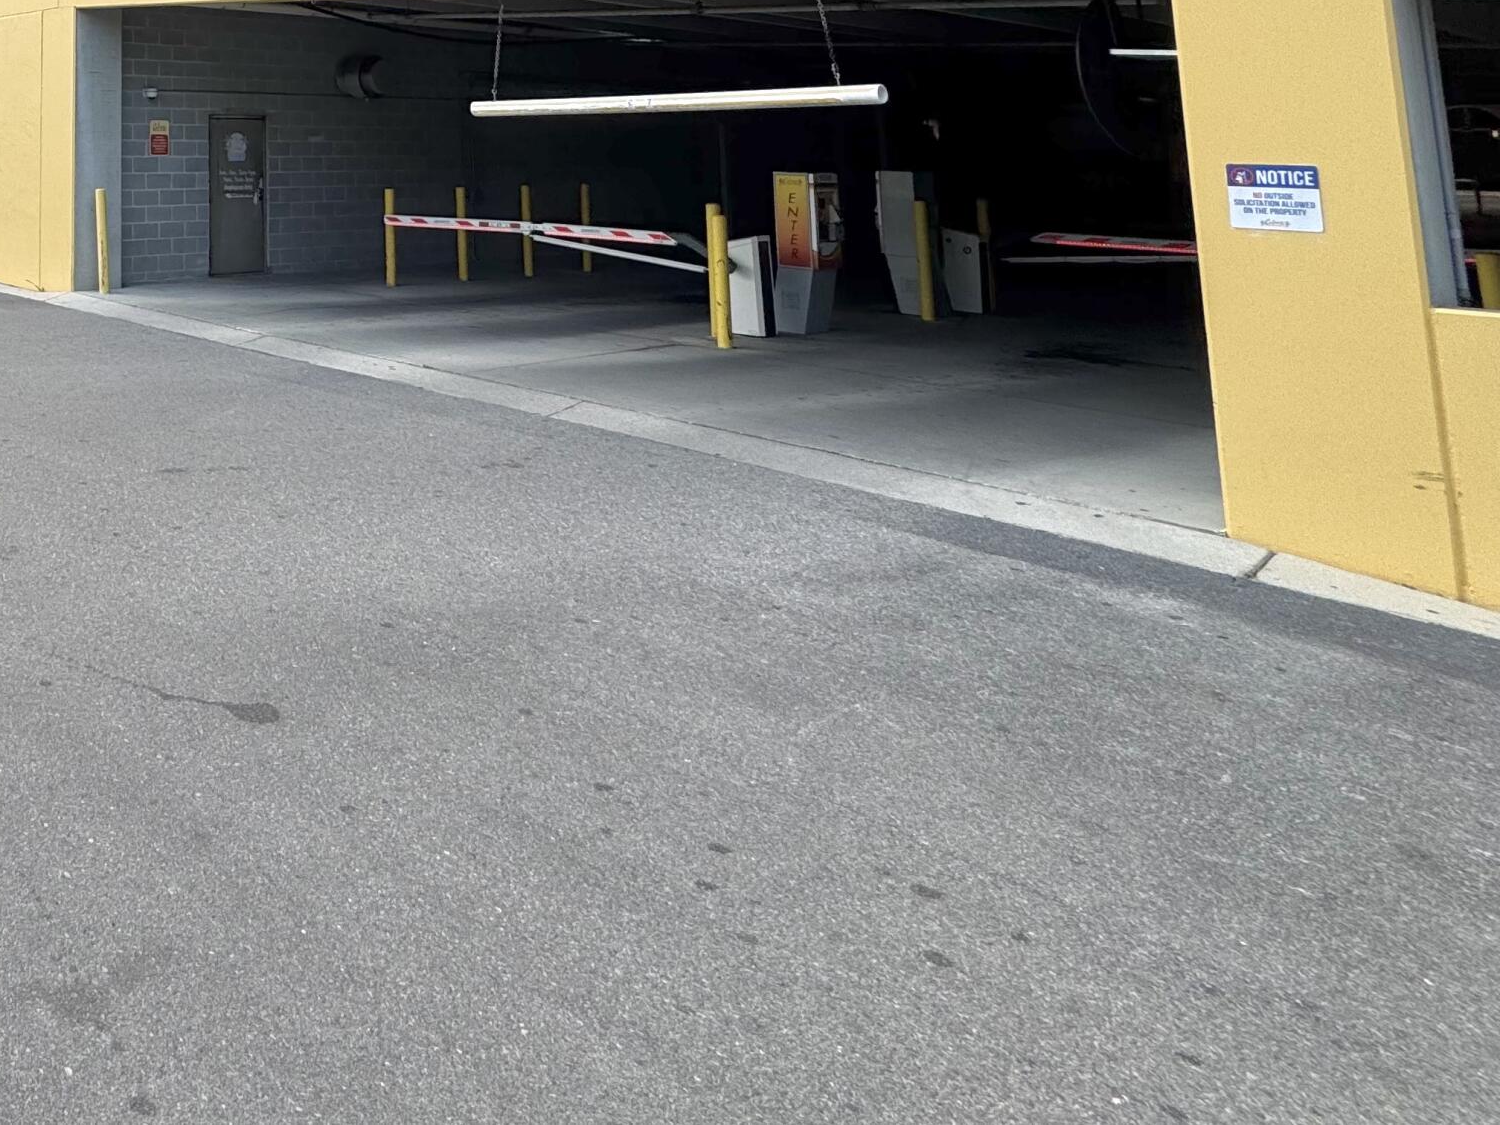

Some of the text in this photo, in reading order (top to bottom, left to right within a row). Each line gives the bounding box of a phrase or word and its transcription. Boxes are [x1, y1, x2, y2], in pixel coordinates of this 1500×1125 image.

[1255, 170, 1315, 186] NOTICE
[1234, 199, 1280, 207] SOLICITATION
[1270, 208, 1307, 216] PROPERTY
[787, 192, 799, 259] ENTER
